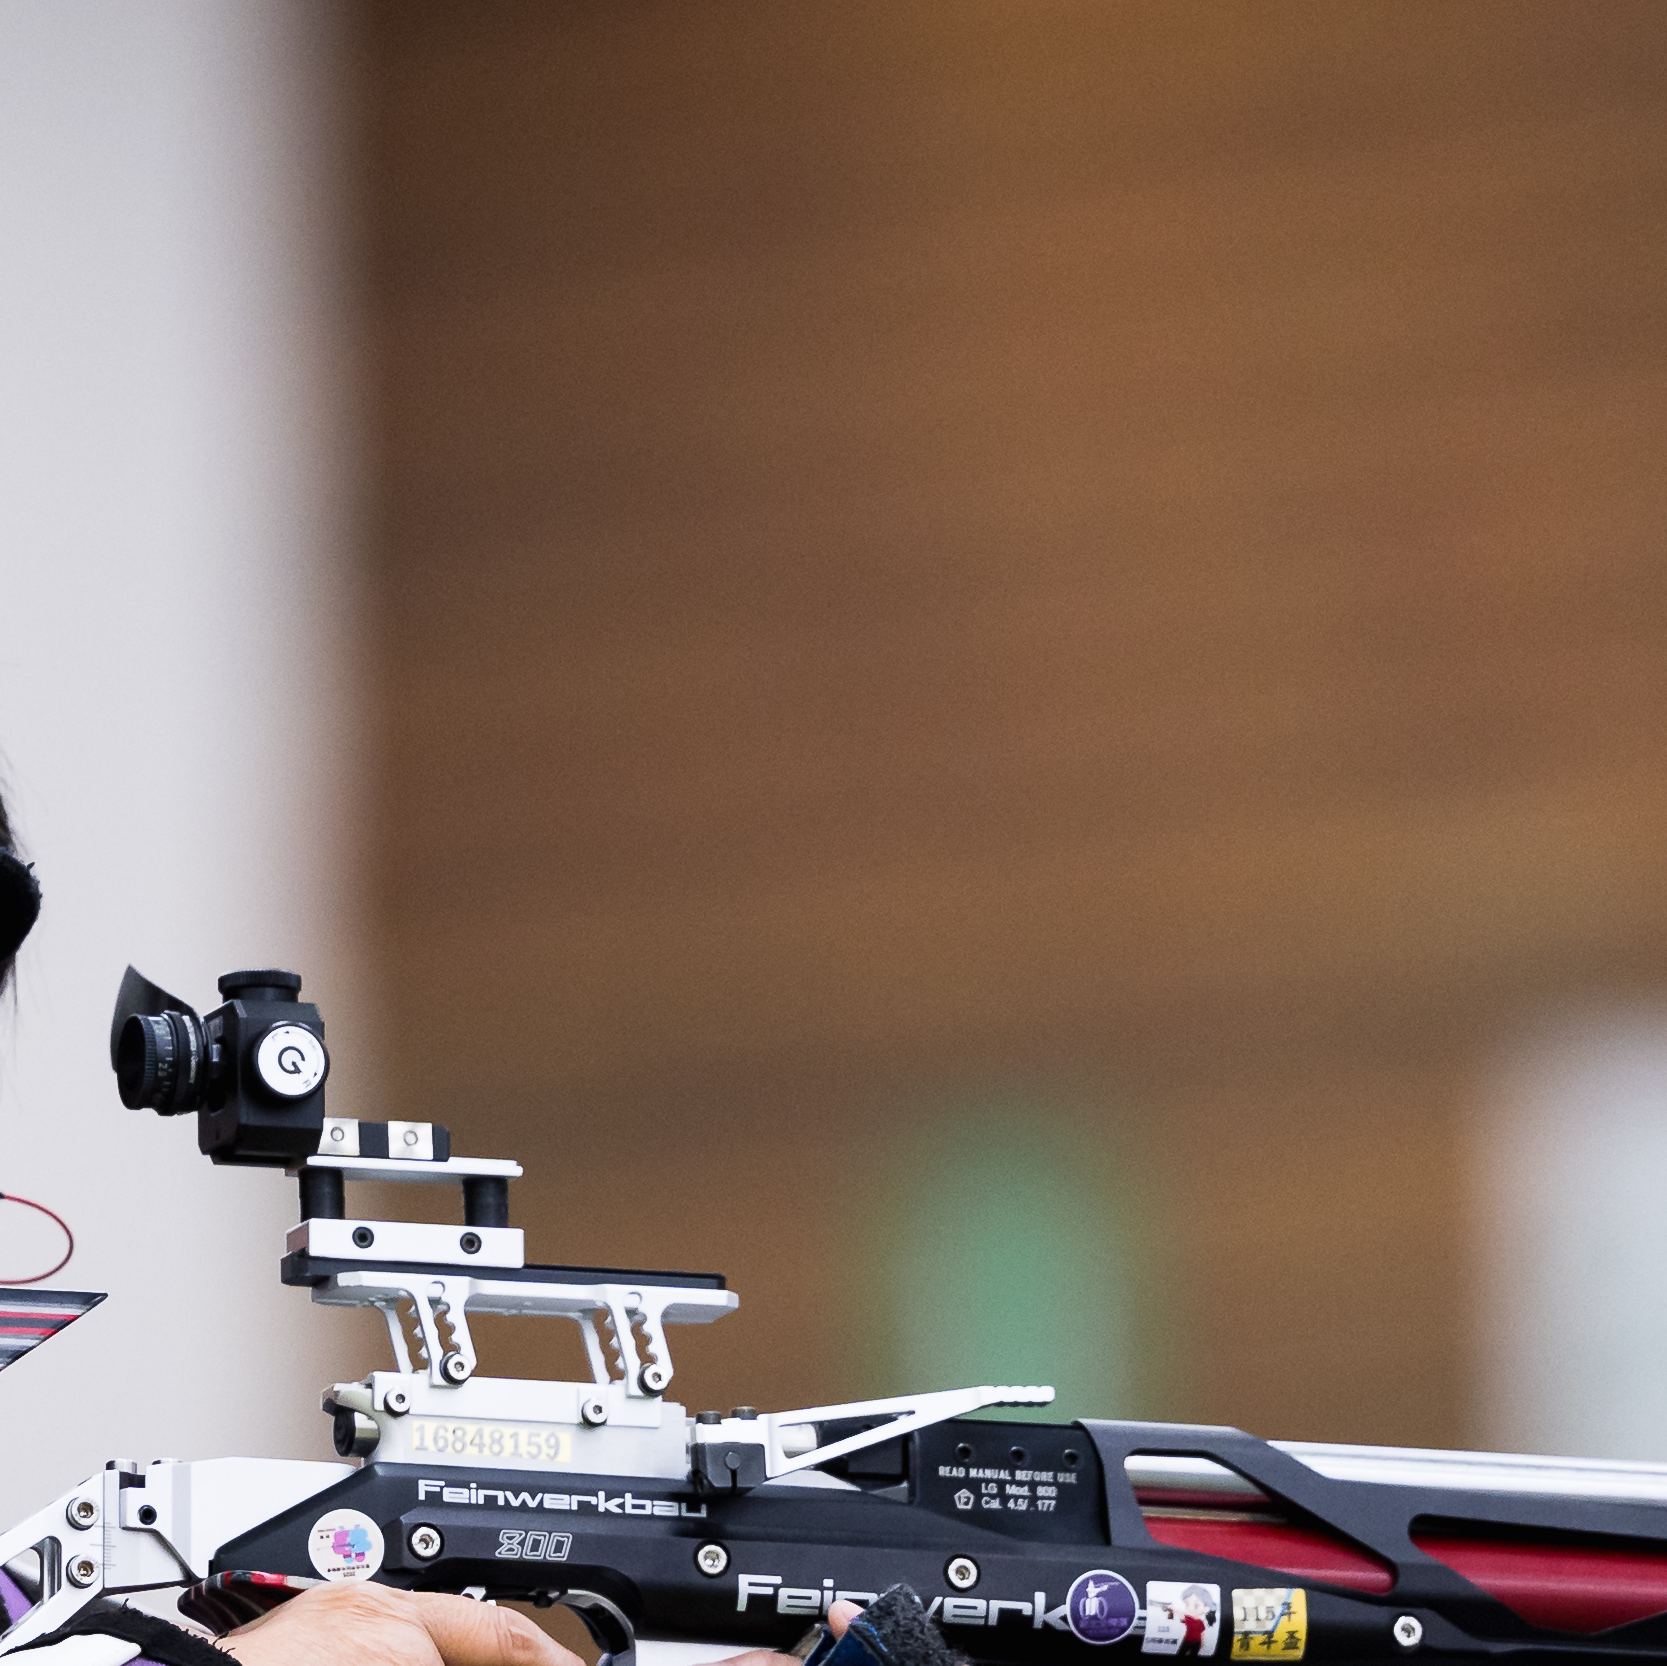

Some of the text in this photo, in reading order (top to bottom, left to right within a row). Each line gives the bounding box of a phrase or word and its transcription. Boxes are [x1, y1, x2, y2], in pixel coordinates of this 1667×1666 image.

[414, 1423, 562, 1461] 16848159
[969, 1467, 1012, 1480] MANUAL
[417, 1479, 707, 1518] Feinwerkbau
[495, 1529, 573, 1562] 800
